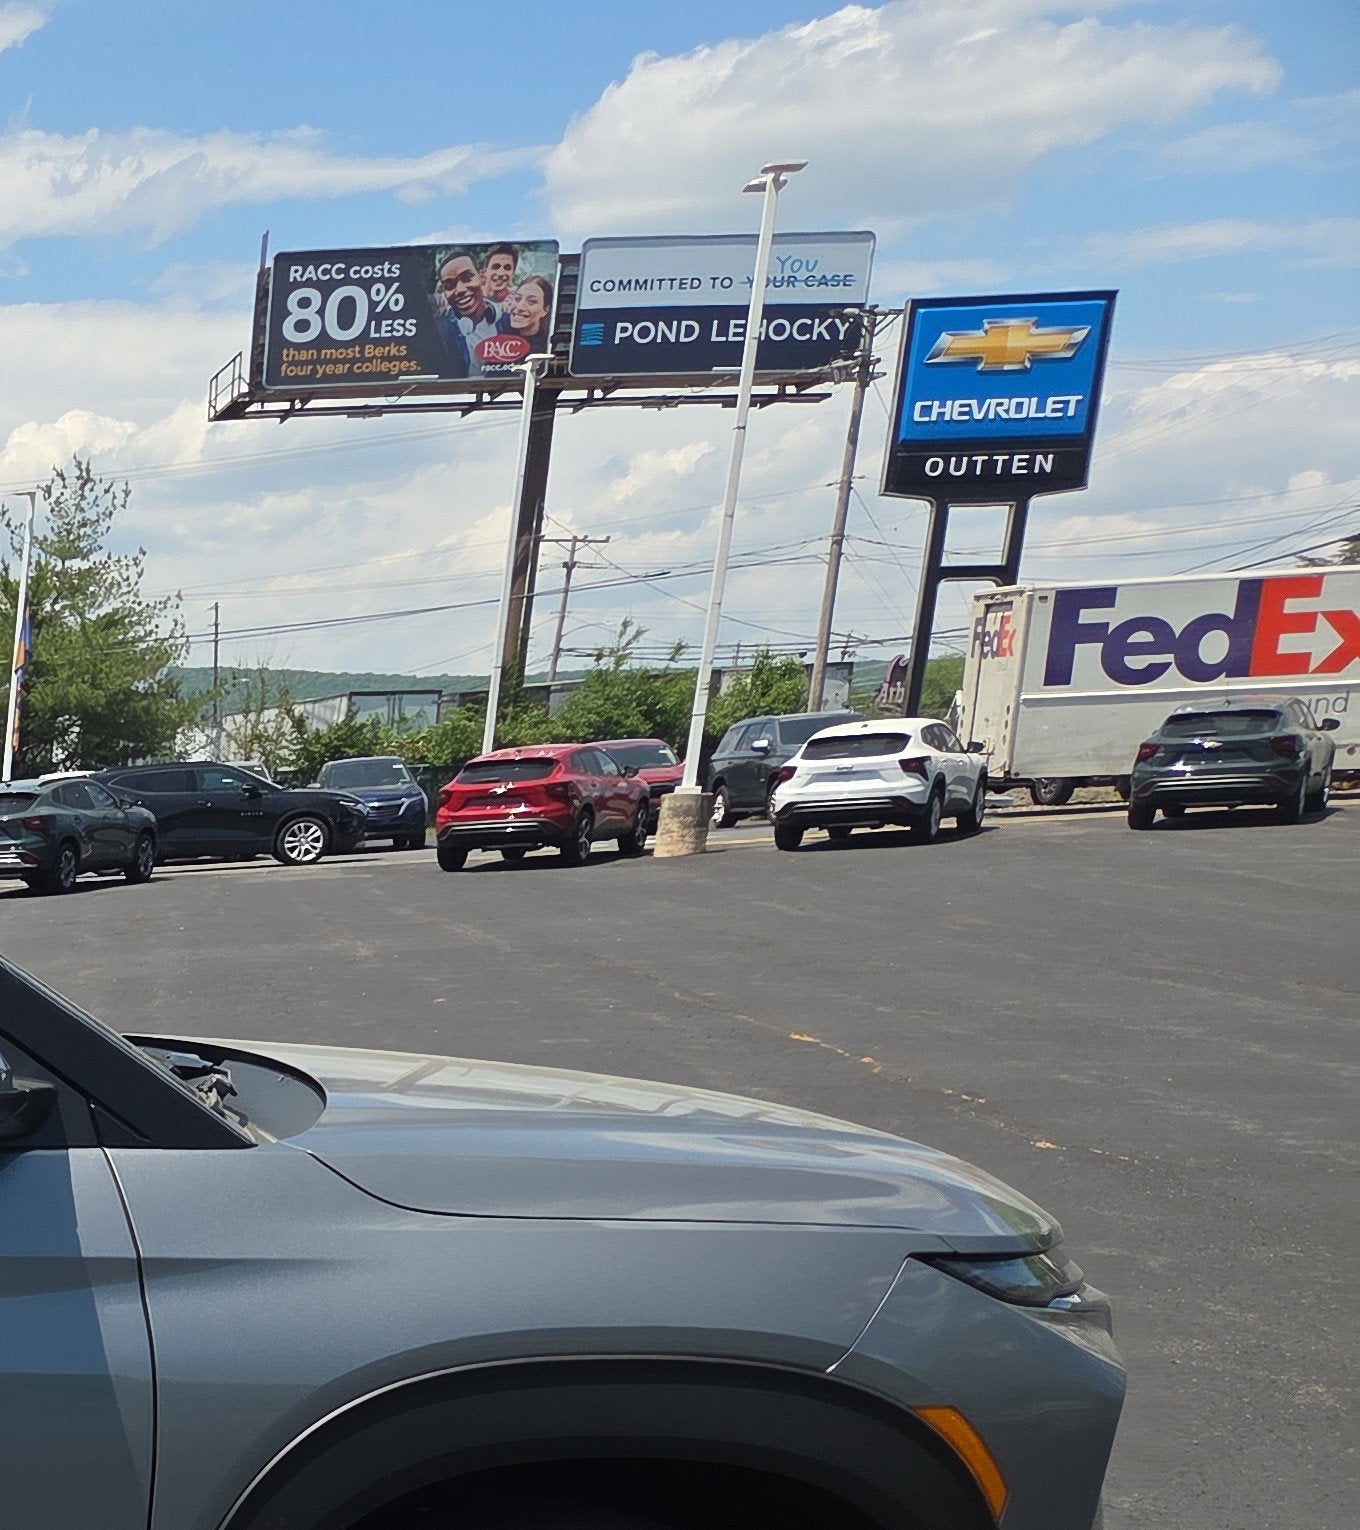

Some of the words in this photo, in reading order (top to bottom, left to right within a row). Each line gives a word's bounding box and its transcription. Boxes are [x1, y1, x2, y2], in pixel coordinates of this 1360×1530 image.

[289, 263, 346, 282] RACC
[349, 261, 401, 278] costs
[775, 255, 819, 274] YOU
[590, 278, 702, 292] COMMITTED
[710, 276, 734, 290] TO
[745, 275, 797, 289] YUR
[804, 274, 855, 288] CASE
[369, 319, 417, 338] LESS
[614, 320, 700, 345] POND
[282, 346, 317, 362] than
[321, 345, 361, 359] most
[364, 342, 407, 357] Berks
[483, 340, 522, 360] RACC
[281, 363, 313, 377] four
[316, 363, 351, 379] year
[353, 359, 422, 375] colleges.
[913, 395, 1084, 422] CHEVROLET
[924, 453, 1055, 477] OUTTEN
[971, 615, 1017, 659] FedEx
